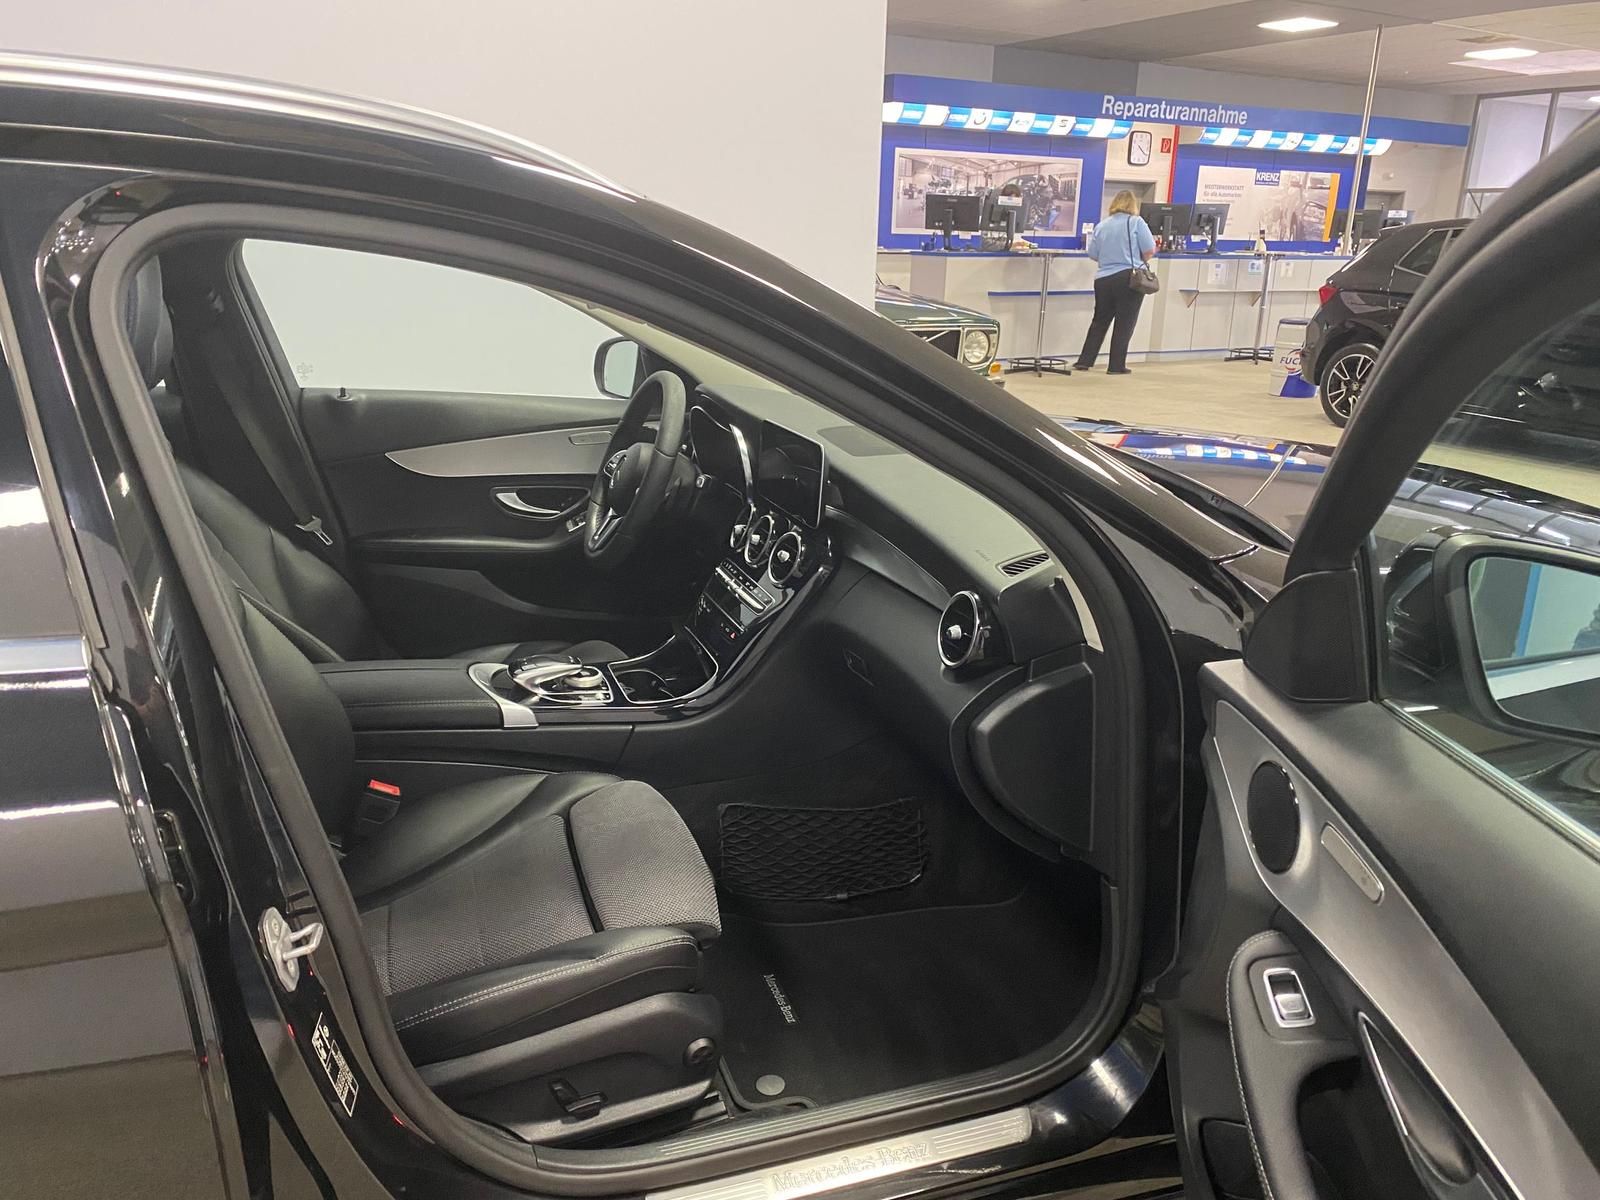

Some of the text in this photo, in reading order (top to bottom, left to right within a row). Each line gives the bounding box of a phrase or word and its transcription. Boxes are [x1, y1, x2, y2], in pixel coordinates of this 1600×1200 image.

[1102, 95, 1248, 125] Reparaturannahme
[1256, 172, 1280, 182] KRENZ
[763, 973, 796, 1024] Mercedes-Benz
[772, 1142, 929, 1192] Mercedes-Benz
